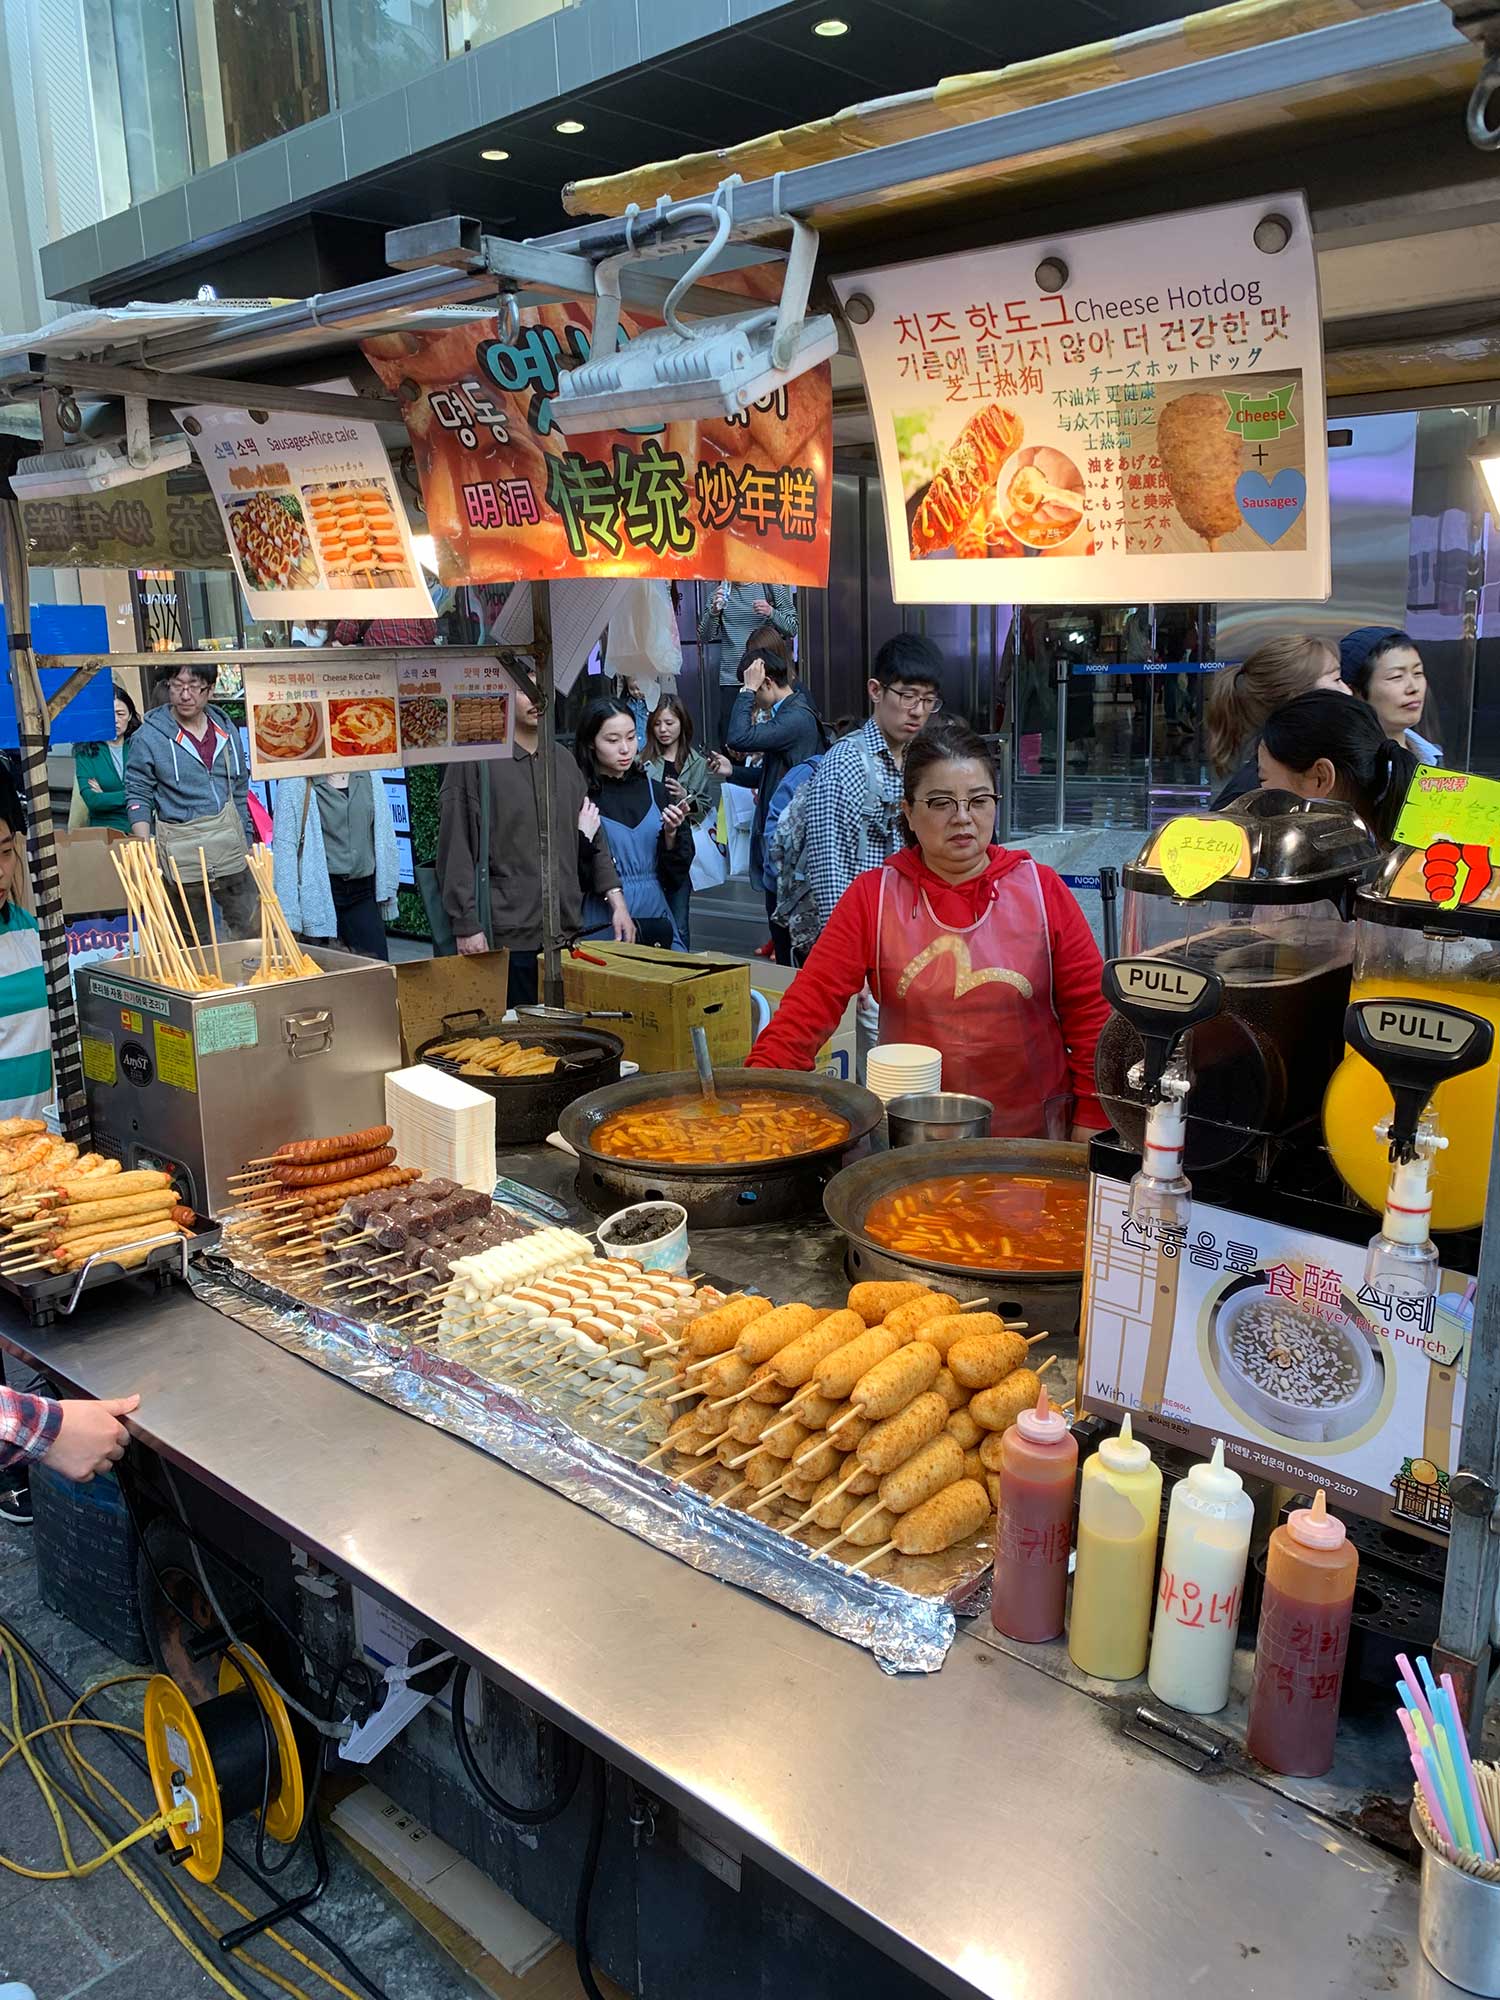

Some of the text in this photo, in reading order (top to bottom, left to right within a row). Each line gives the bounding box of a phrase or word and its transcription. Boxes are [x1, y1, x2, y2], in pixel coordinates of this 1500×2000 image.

[1075, 279, 1262, 322] Cheese Hotdog
[893, 295, 1074, 350] 치즈 핫도그
[897, 305, 1291, 381] 기름에 튀기지 않아 더 건강한 맛
[1089, 348, 1262, 383] チーズホットドッグ
[943, 365, 1043, 402] 芝士热狗
[1051, 381, 1157, 408] 不油炸 更健康
[427, 381, 510, 450] 명동
[1057, 407, 1157, 432] 与众不同的芝
[1235, 407, 1286, 423] Cheese
[237, 437, 260, 457] 소떡
[266, 426, 359, 452] Sausages+Rice cake
[1083, 431, 1132, 451] 士热狗
[463, 439, 819, 560] 明洞 传统 炒年糕
[1242, 496, 1298, 509] Sausages
[268, 672, 315, 684] 치즈 떡볶이
[322, 672, 380, 682] Cheese Rice Cake
[422, 668, 437, 678] 소떡
[1143, 663, 1168, 671] NOON
[1419, 776, 1468, 793] 인기상품
[65, 928, 130, 956] ictor
[1128, 967, 1189, 996] PULL
[1379, 1011, 1453, 1044] PULL
[1356, 1281, 1437, 1333] 식혜
[1355, 1316, 1390, 1338] Rice
[1394, 1328, 1447, 1355] Punch
[1096, 1380, 1125, 1403] With
[1286, 1463, 1359, 1497] 010-9089-2507
